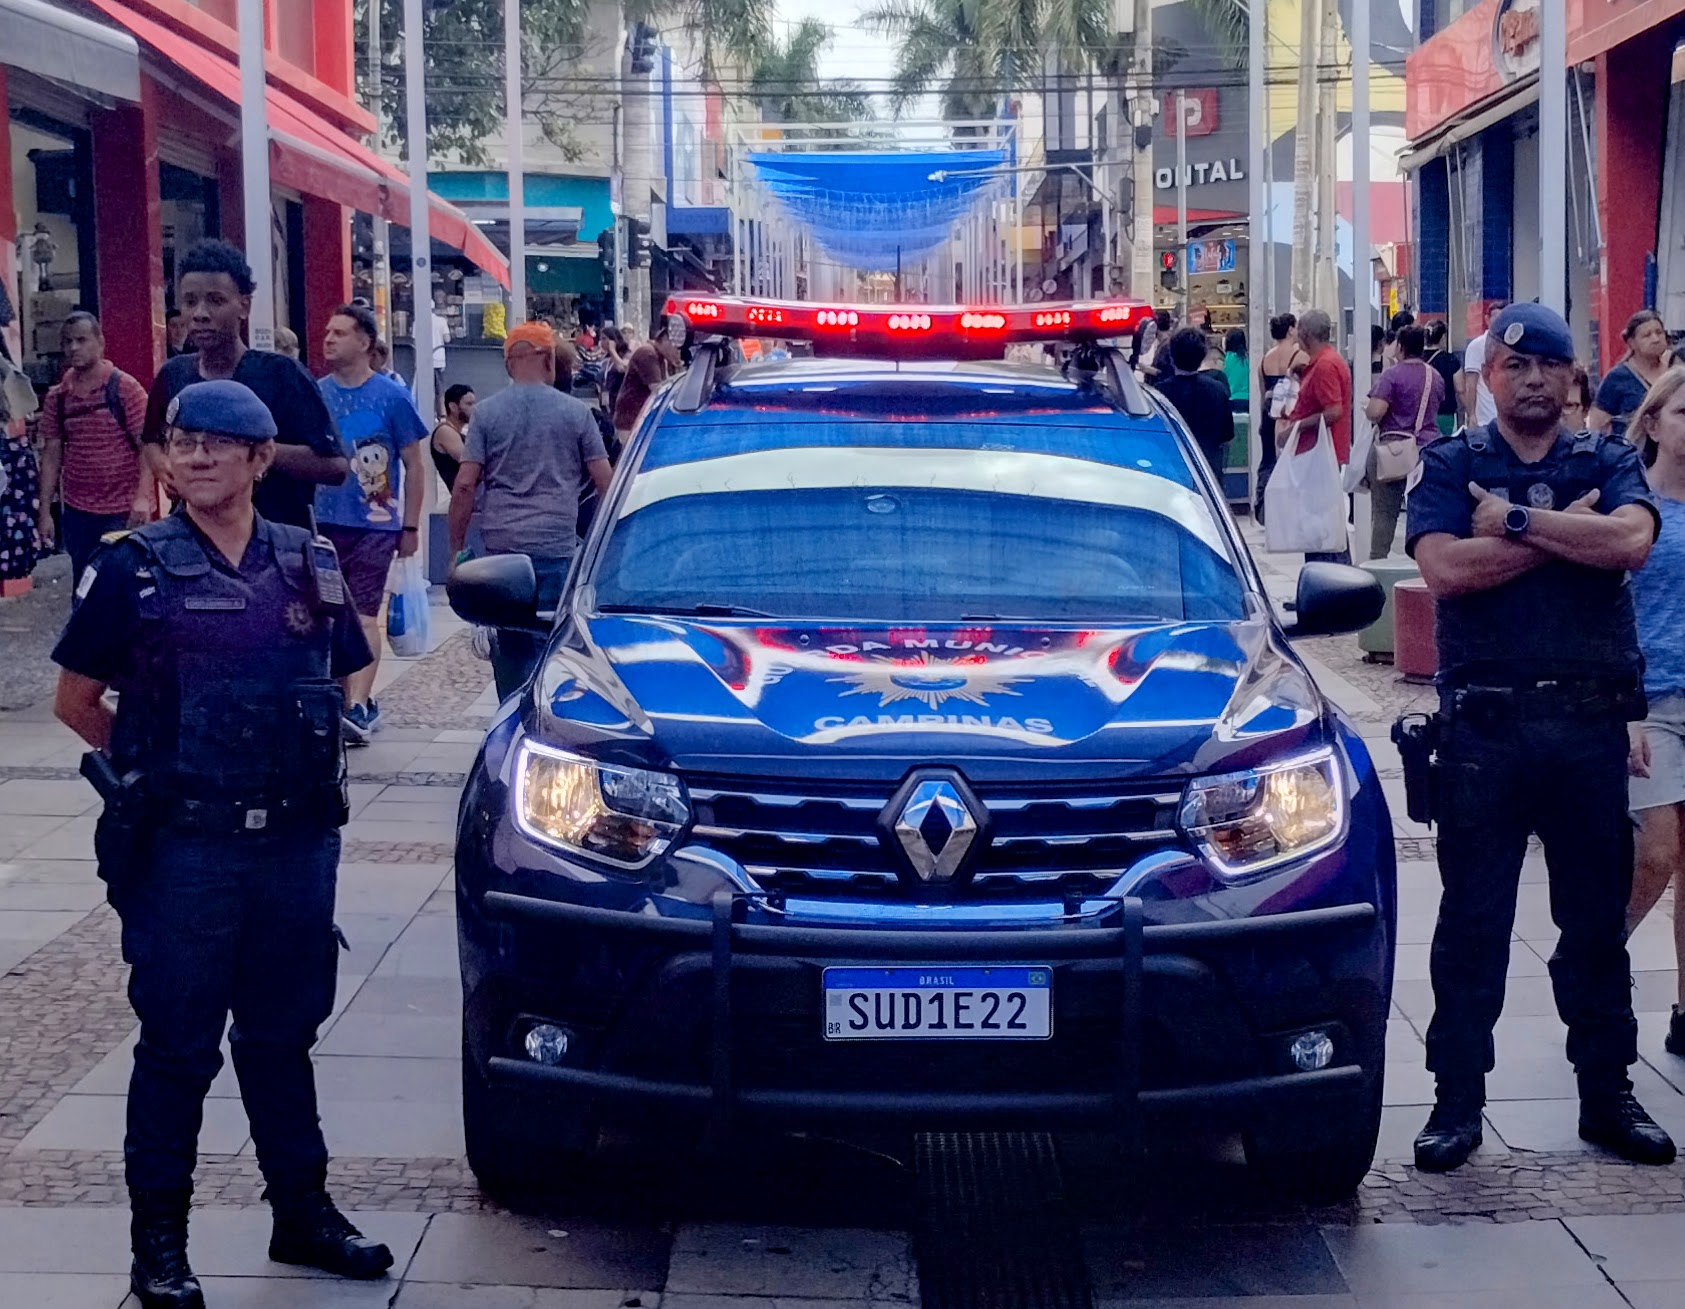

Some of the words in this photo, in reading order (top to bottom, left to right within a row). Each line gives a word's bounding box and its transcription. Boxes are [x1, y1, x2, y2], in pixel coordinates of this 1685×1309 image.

[1156, 158, 1244, 189] ONTAL
[813, 714, 1054, 733] CAMPINAS
[919, 976, 954, 985] BRASIL
[848, 992, 1027, 1030] SUD1E22
[828, 1022, 841, 1034] BR
